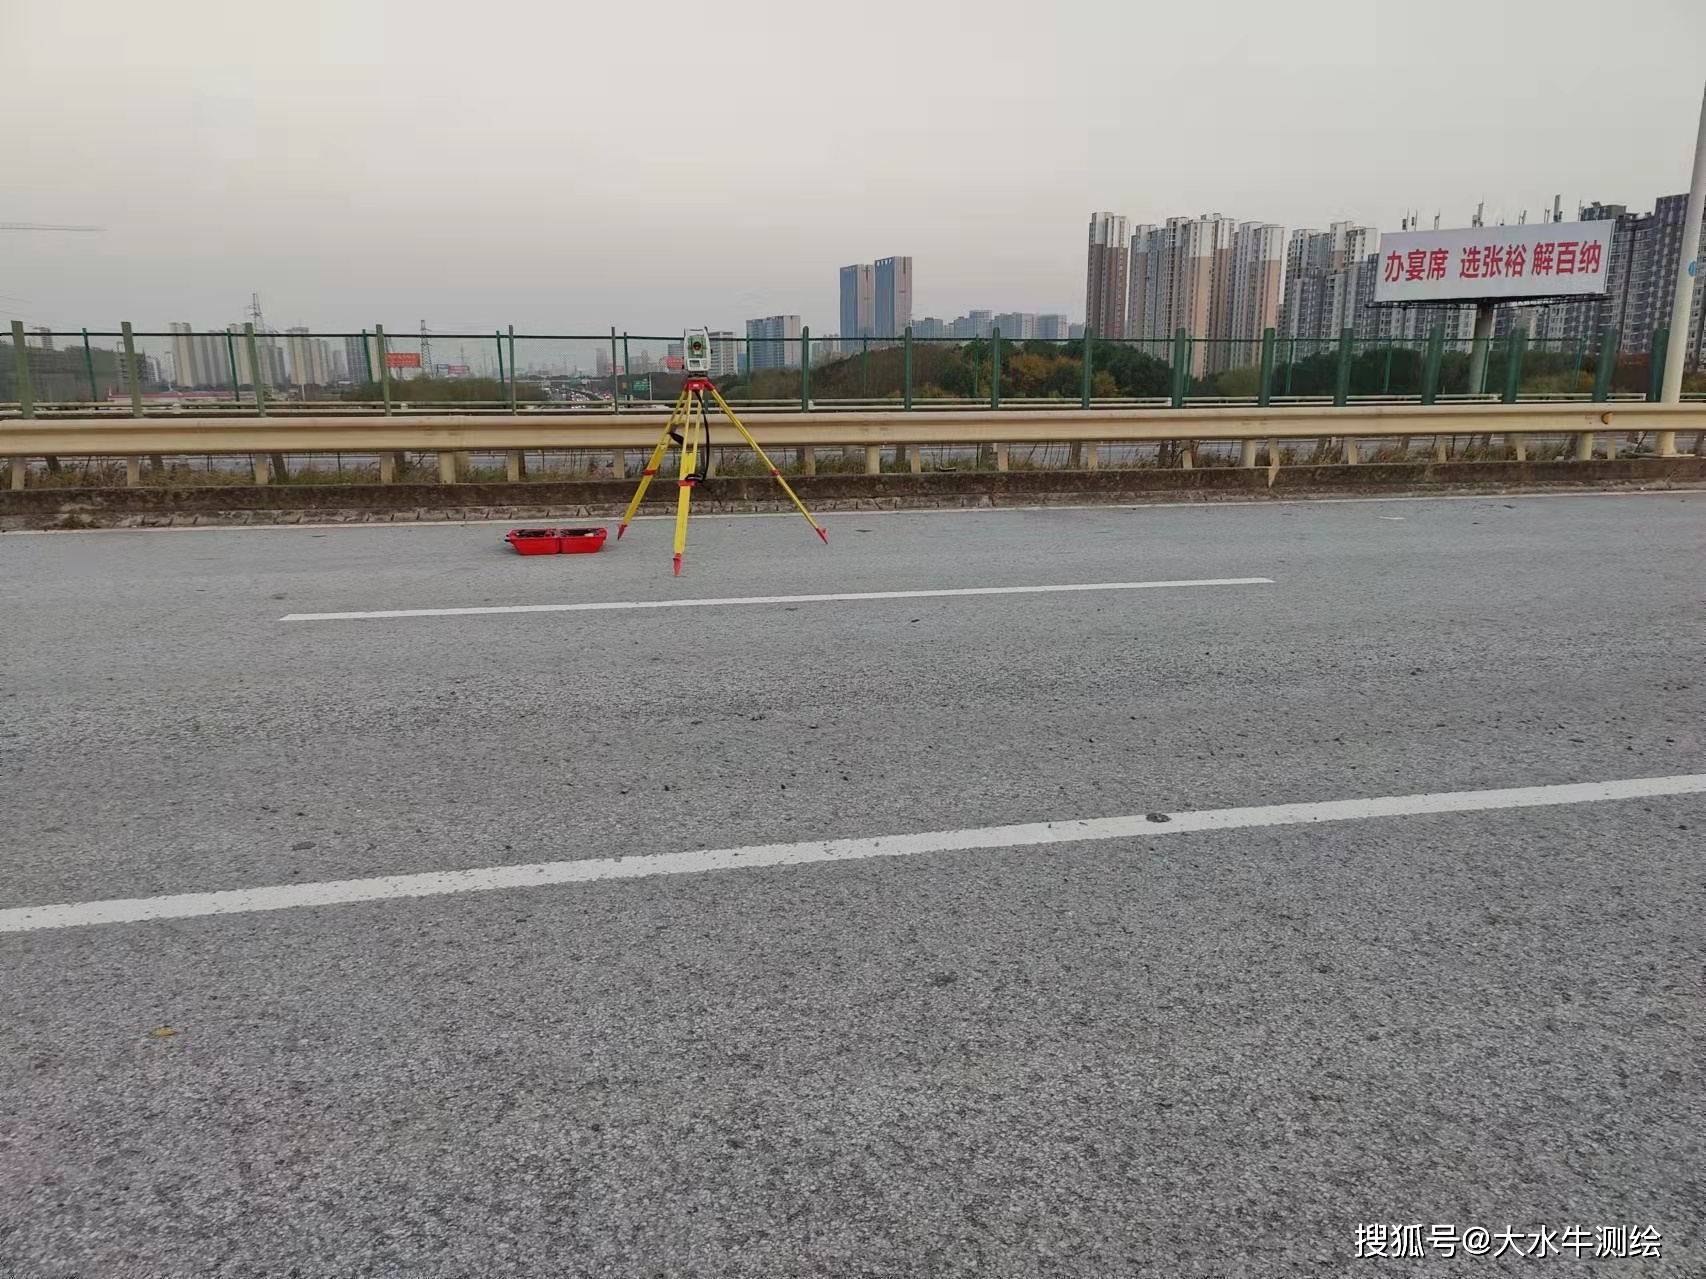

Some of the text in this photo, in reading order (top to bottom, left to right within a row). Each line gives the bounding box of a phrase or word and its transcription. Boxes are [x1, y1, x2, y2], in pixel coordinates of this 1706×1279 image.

[1384, 240, 1602, 282] 办宴席 选张裕 解百纳
